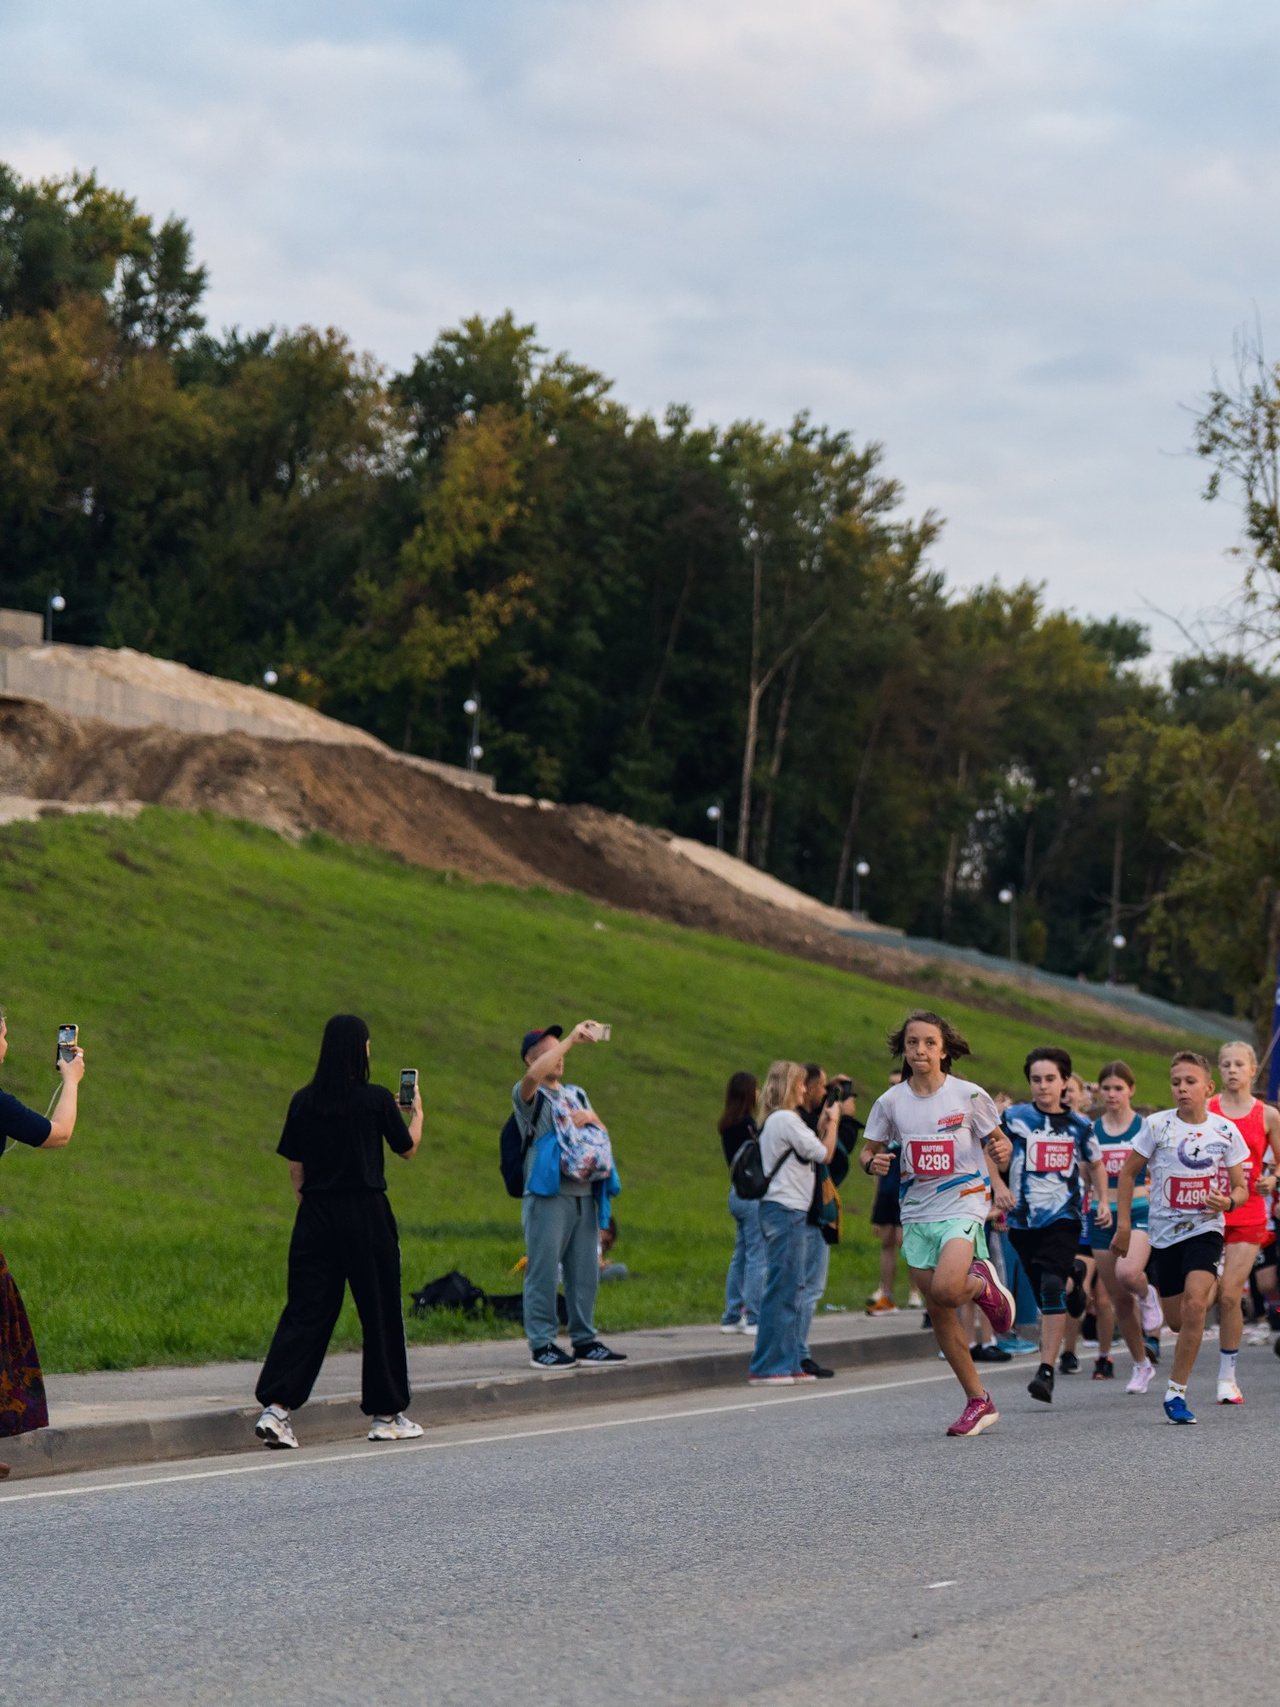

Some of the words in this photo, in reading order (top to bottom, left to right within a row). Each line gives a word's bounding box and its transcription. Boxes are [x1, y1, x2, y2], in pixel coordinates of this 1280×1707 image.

[921, 1145, 944, 1153] МАРТИН
[917, 1153, 950, 1171] 4298
[1044, 1153, 1070, 1168] 1586
[1175, 1189, 1207, 1205] 4499
